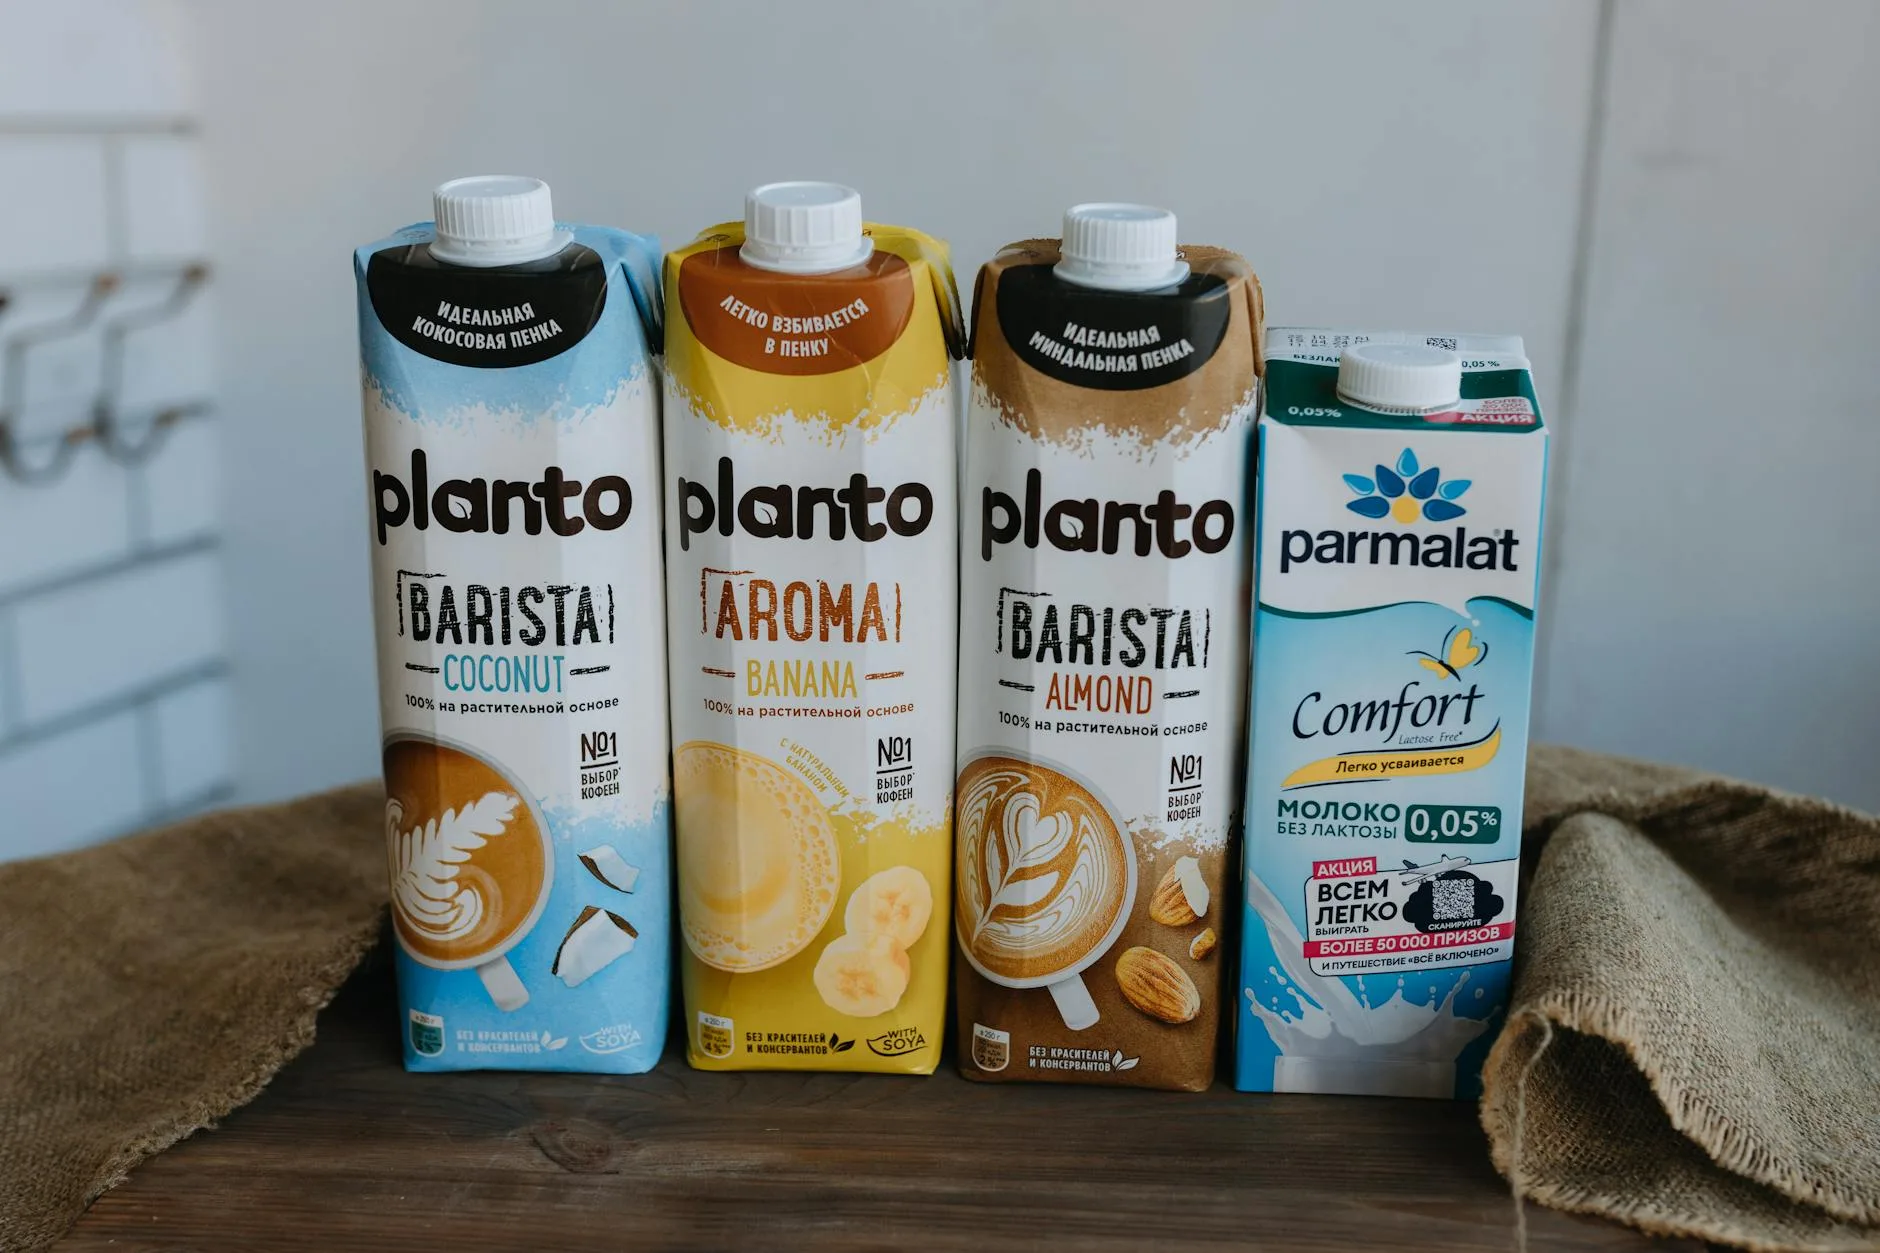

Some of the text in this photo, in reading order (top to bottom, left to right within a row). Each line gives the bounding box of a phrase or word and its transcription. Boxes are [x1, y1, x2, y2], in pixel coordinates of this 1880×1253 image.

[437, 300, 535, 326] ИДЕАЛЬНАЯ
[720, 295, 870, 334] ЛЕГКО ВЗБИВАЕТСЯ
[412, 315, 563, 350] КОКОСОВАЯ ПЕНКА
[1063, 322, 1161, 349] ИДЕАЛЬНАЯ
[765, 338, 829, 357] В ПЕНКУ
[1029, 331, 1195, 373] МИНДАЛЬНАЯ ПЕНКА
[1288, 405, 1342, 418] 0,05%
[373, 449, 632, 545] planto
[678, 456, 934, 551] planto
[981, 468, 1234, 561] planto
[1280, 526, 1519, 574] parmalat
[410, 582, 601, 646] BARISTA
[715, 579, 888, 643] AROMA
[1011, 601, 1196, 669] BARISTA
[443, 653, 565, 693] COCONUT
[746, 660, 858, 698] BANANA
[405, 694, 619, 715] 100% на растительной основе
[1046, 672, 1152, 715] ALMOND
[704, 698, 914, 719] 100% на растительной основе
[1292, 681, 1485, 743] Comfort
[999, 711, 1208, 736] 100% на растительной основе
[1398, 734, 1434, 745] Lactose
[1336, 755, 1464, 774] Легко усваивается
[581, 783, 620, 800] КОФЕЕН
[877, 787, 913, 804] КОФЕЕН
[1167, 807, 1201, 822] КОФЕЕН
[1278, 799, 1400, 822] МОЛОКО
[1277, 822, 1397, 839] БЕЗ ЛАКТОЗЫ
[1410, 808, 1498, 840] 0,05%
[1317, 859, 1374, 877] АКЦИЯ
[1318, 879, 1389, 903] ВСЕМ
[1315, 901, 1398, 926] ЛЕГКО
[1428, 918, 1482, 931] СКАНИРУЙТЕ
[1315, 925, 1369, 936] ВЫИГРАТЬ
[1319, 927, 1501, 955] БОЛЕЕ 50 000 ПРИЗОВ
[1322, 962, 1330, 971] И
[1332, 957, 1407, 971] ПУТЕШЕСТВИЕ
[1435, 947, 1499, 962] ВКЛЮЧЕНО»
[595, 1030, 641, 1048] SOYA
[600, 1023, 632, 1036] WITH
[746, 1032, 826, 1044] БЕЗ КРАСИТЕЛЕЙ
[887, 1026, 918, 1039] WITH
[747, 1043, 828, 1055] И КОНСЕРВАНТОВ
[882, 1035, 926, 1051] SOYA
[1029, 1046, 1110, 1061] БЕЗ КРАСИТЕЛЕЙ
[1029, 1058, 1111, 1072] И КОНСЕРВАНТОВ
